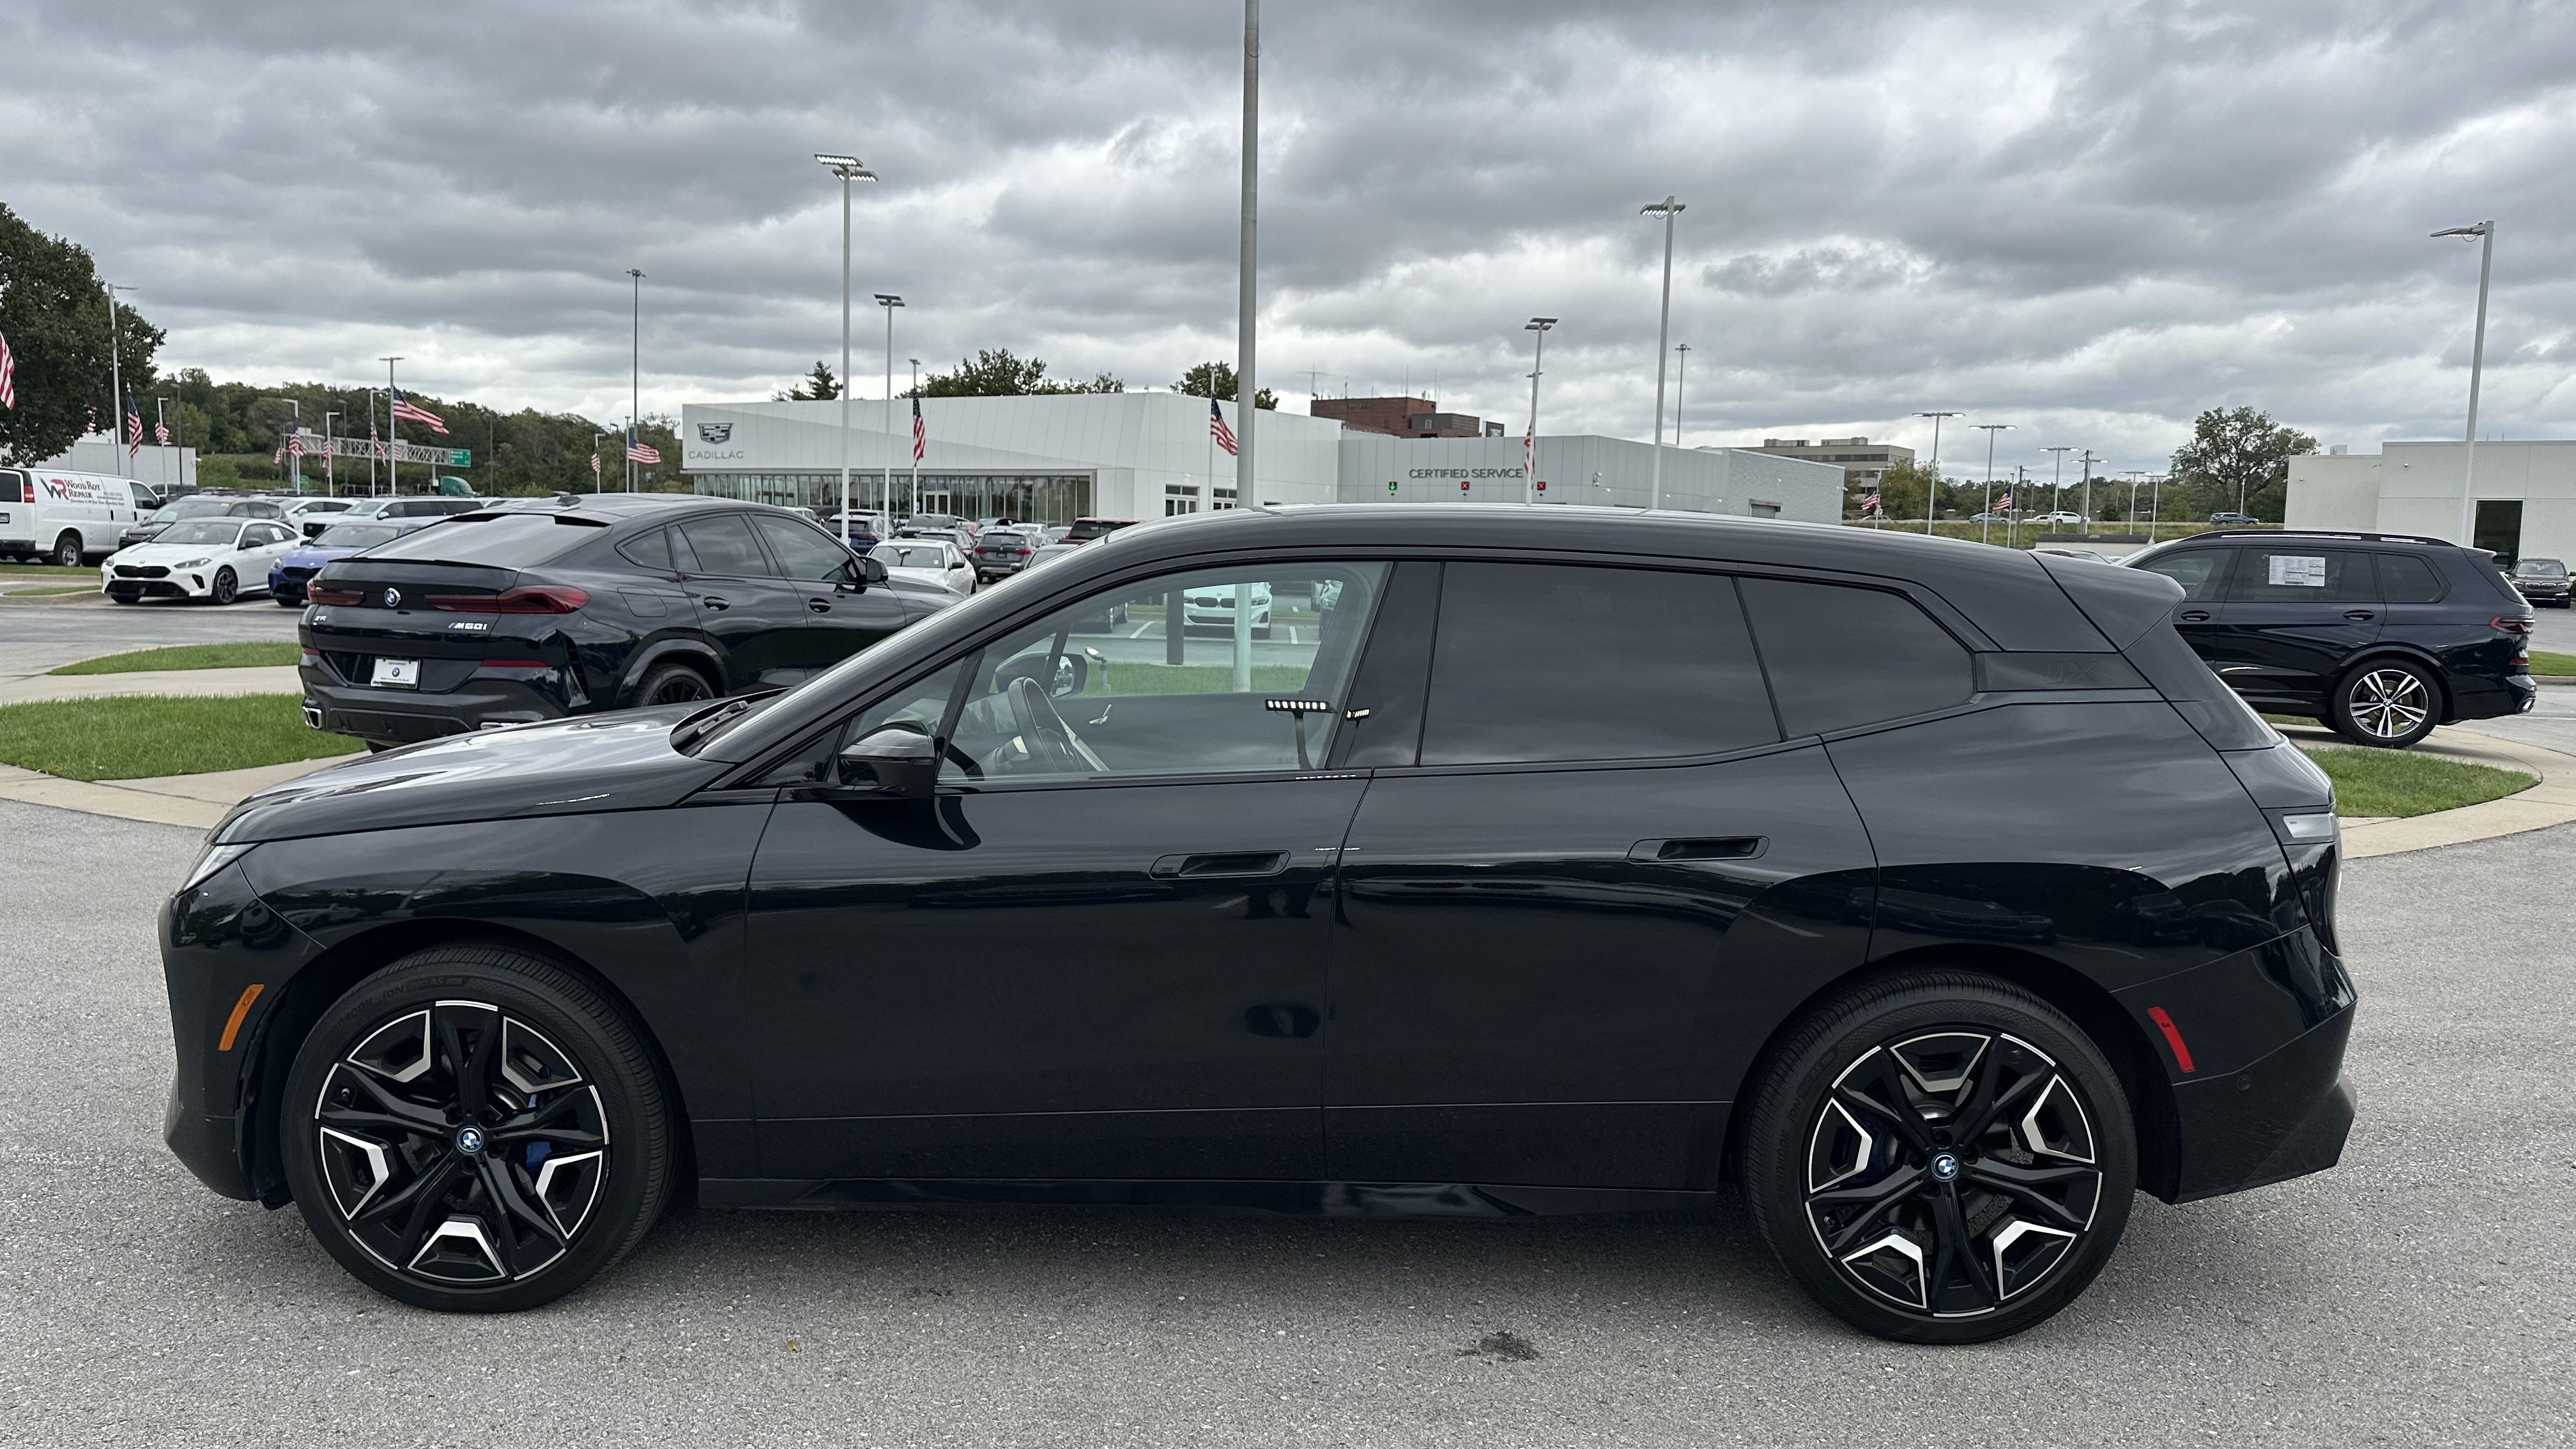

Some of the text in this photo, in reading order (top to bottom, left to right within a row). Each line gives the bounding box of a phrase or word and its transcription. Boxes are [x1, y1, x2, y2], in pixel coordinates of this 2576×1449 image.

[688, 450, 744, 459] CADILLAC
[1409, 468, 1524, 479] CERTIFIED SERVICE
